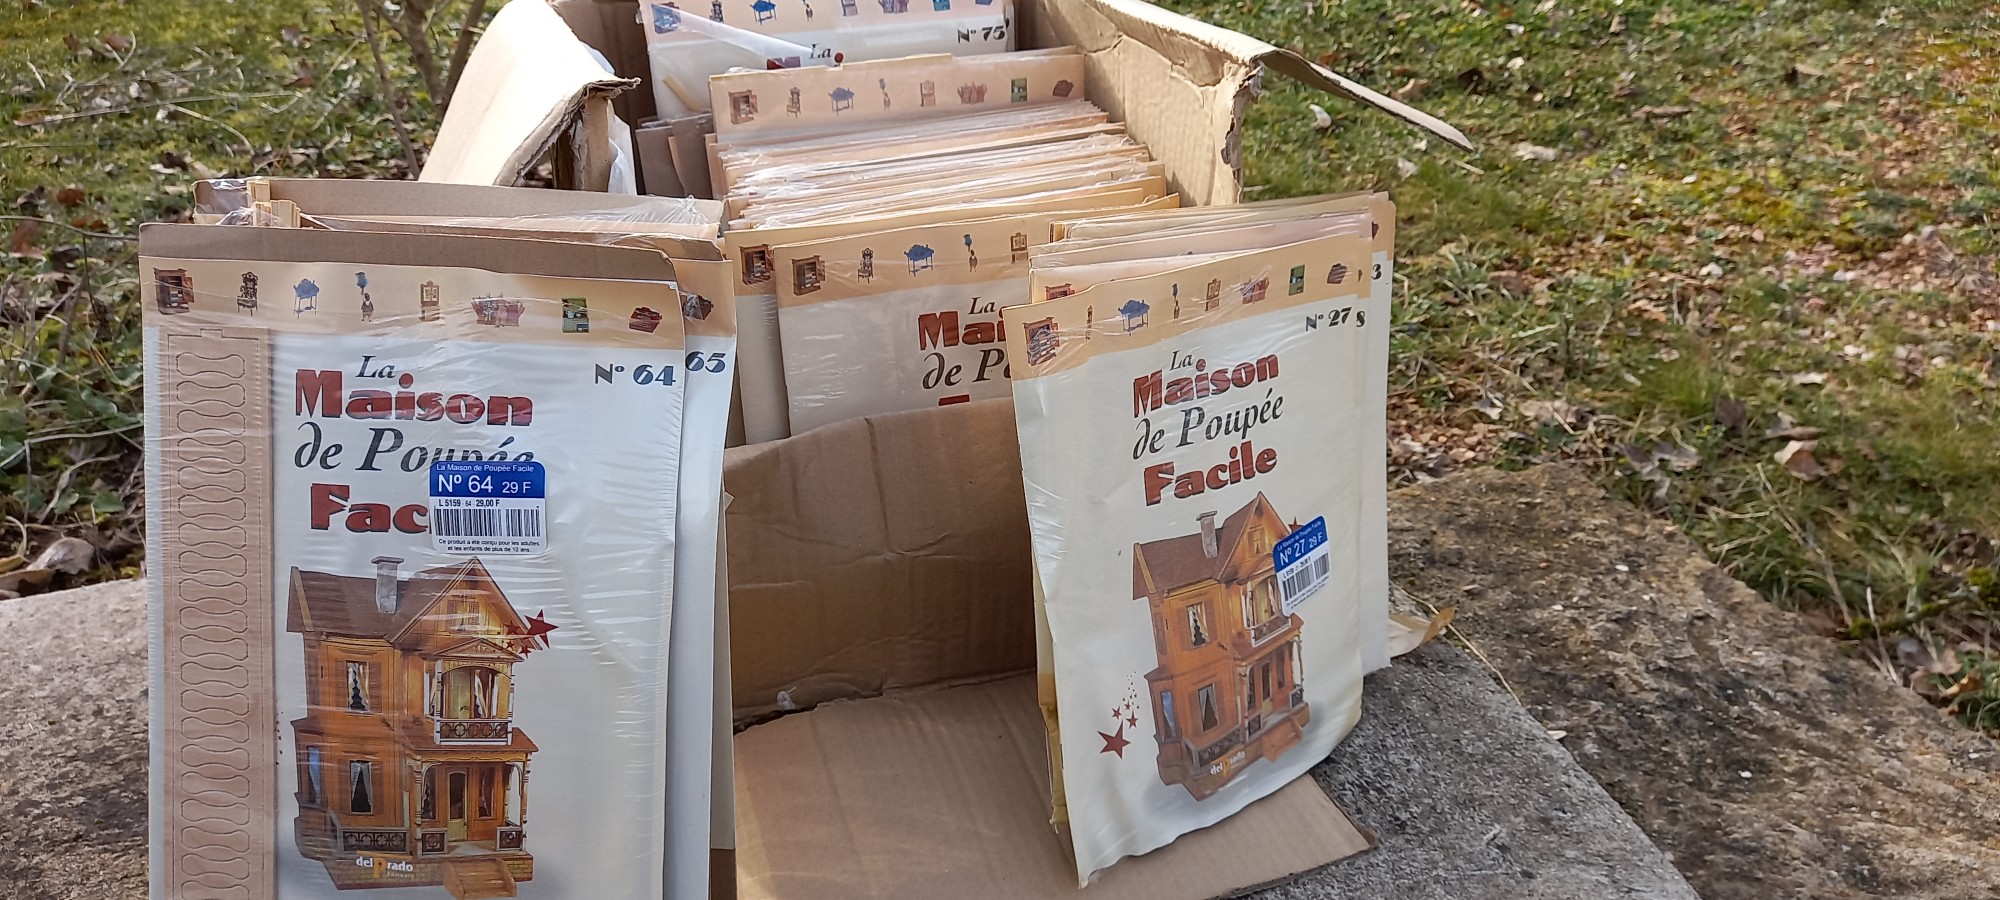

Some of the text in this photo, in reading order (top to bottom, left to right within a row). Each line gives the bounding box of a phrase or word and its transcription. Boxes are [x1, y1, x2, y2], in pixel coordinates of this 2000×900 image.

[981, 25, 1005, 41] 75
[968, 296, 997, 315] La
[1328, 306, 1353, 328] 27
[355, 355, 396, 380] La
[685, 351, 726, 373] 65
[922, 352, 962, 389] de
[1169, 350, 1193, 371] La
[633, 364, 677, 386] 64
[1133, 353, 1280, 418] Maison
[295, 368, 533, 426] Maison
[1132, 387, 1284, 460] de Poupée
[294, 421, 343, 470] de
[436, 463, 446, 471] La
[447, 463, 472, 471] Maison
[484, 464, 511, 473] Poupée
[1143, 440, 1278, 507] Facile
[468, 475, 493, 493] 64
[502, 481, 518, 494] 29
[522, 481, 532, 494] F
[438, 499, 444, 507] L
[445, 499, 461, 507] 5159
[476, 499, 494, 508] 29,00
[495, 499, 500, 507] F
[1294, 539, 1306, 558] 27
[1309, 536, 1317, 549] 29
[1317, 532, 1323, 542] F
